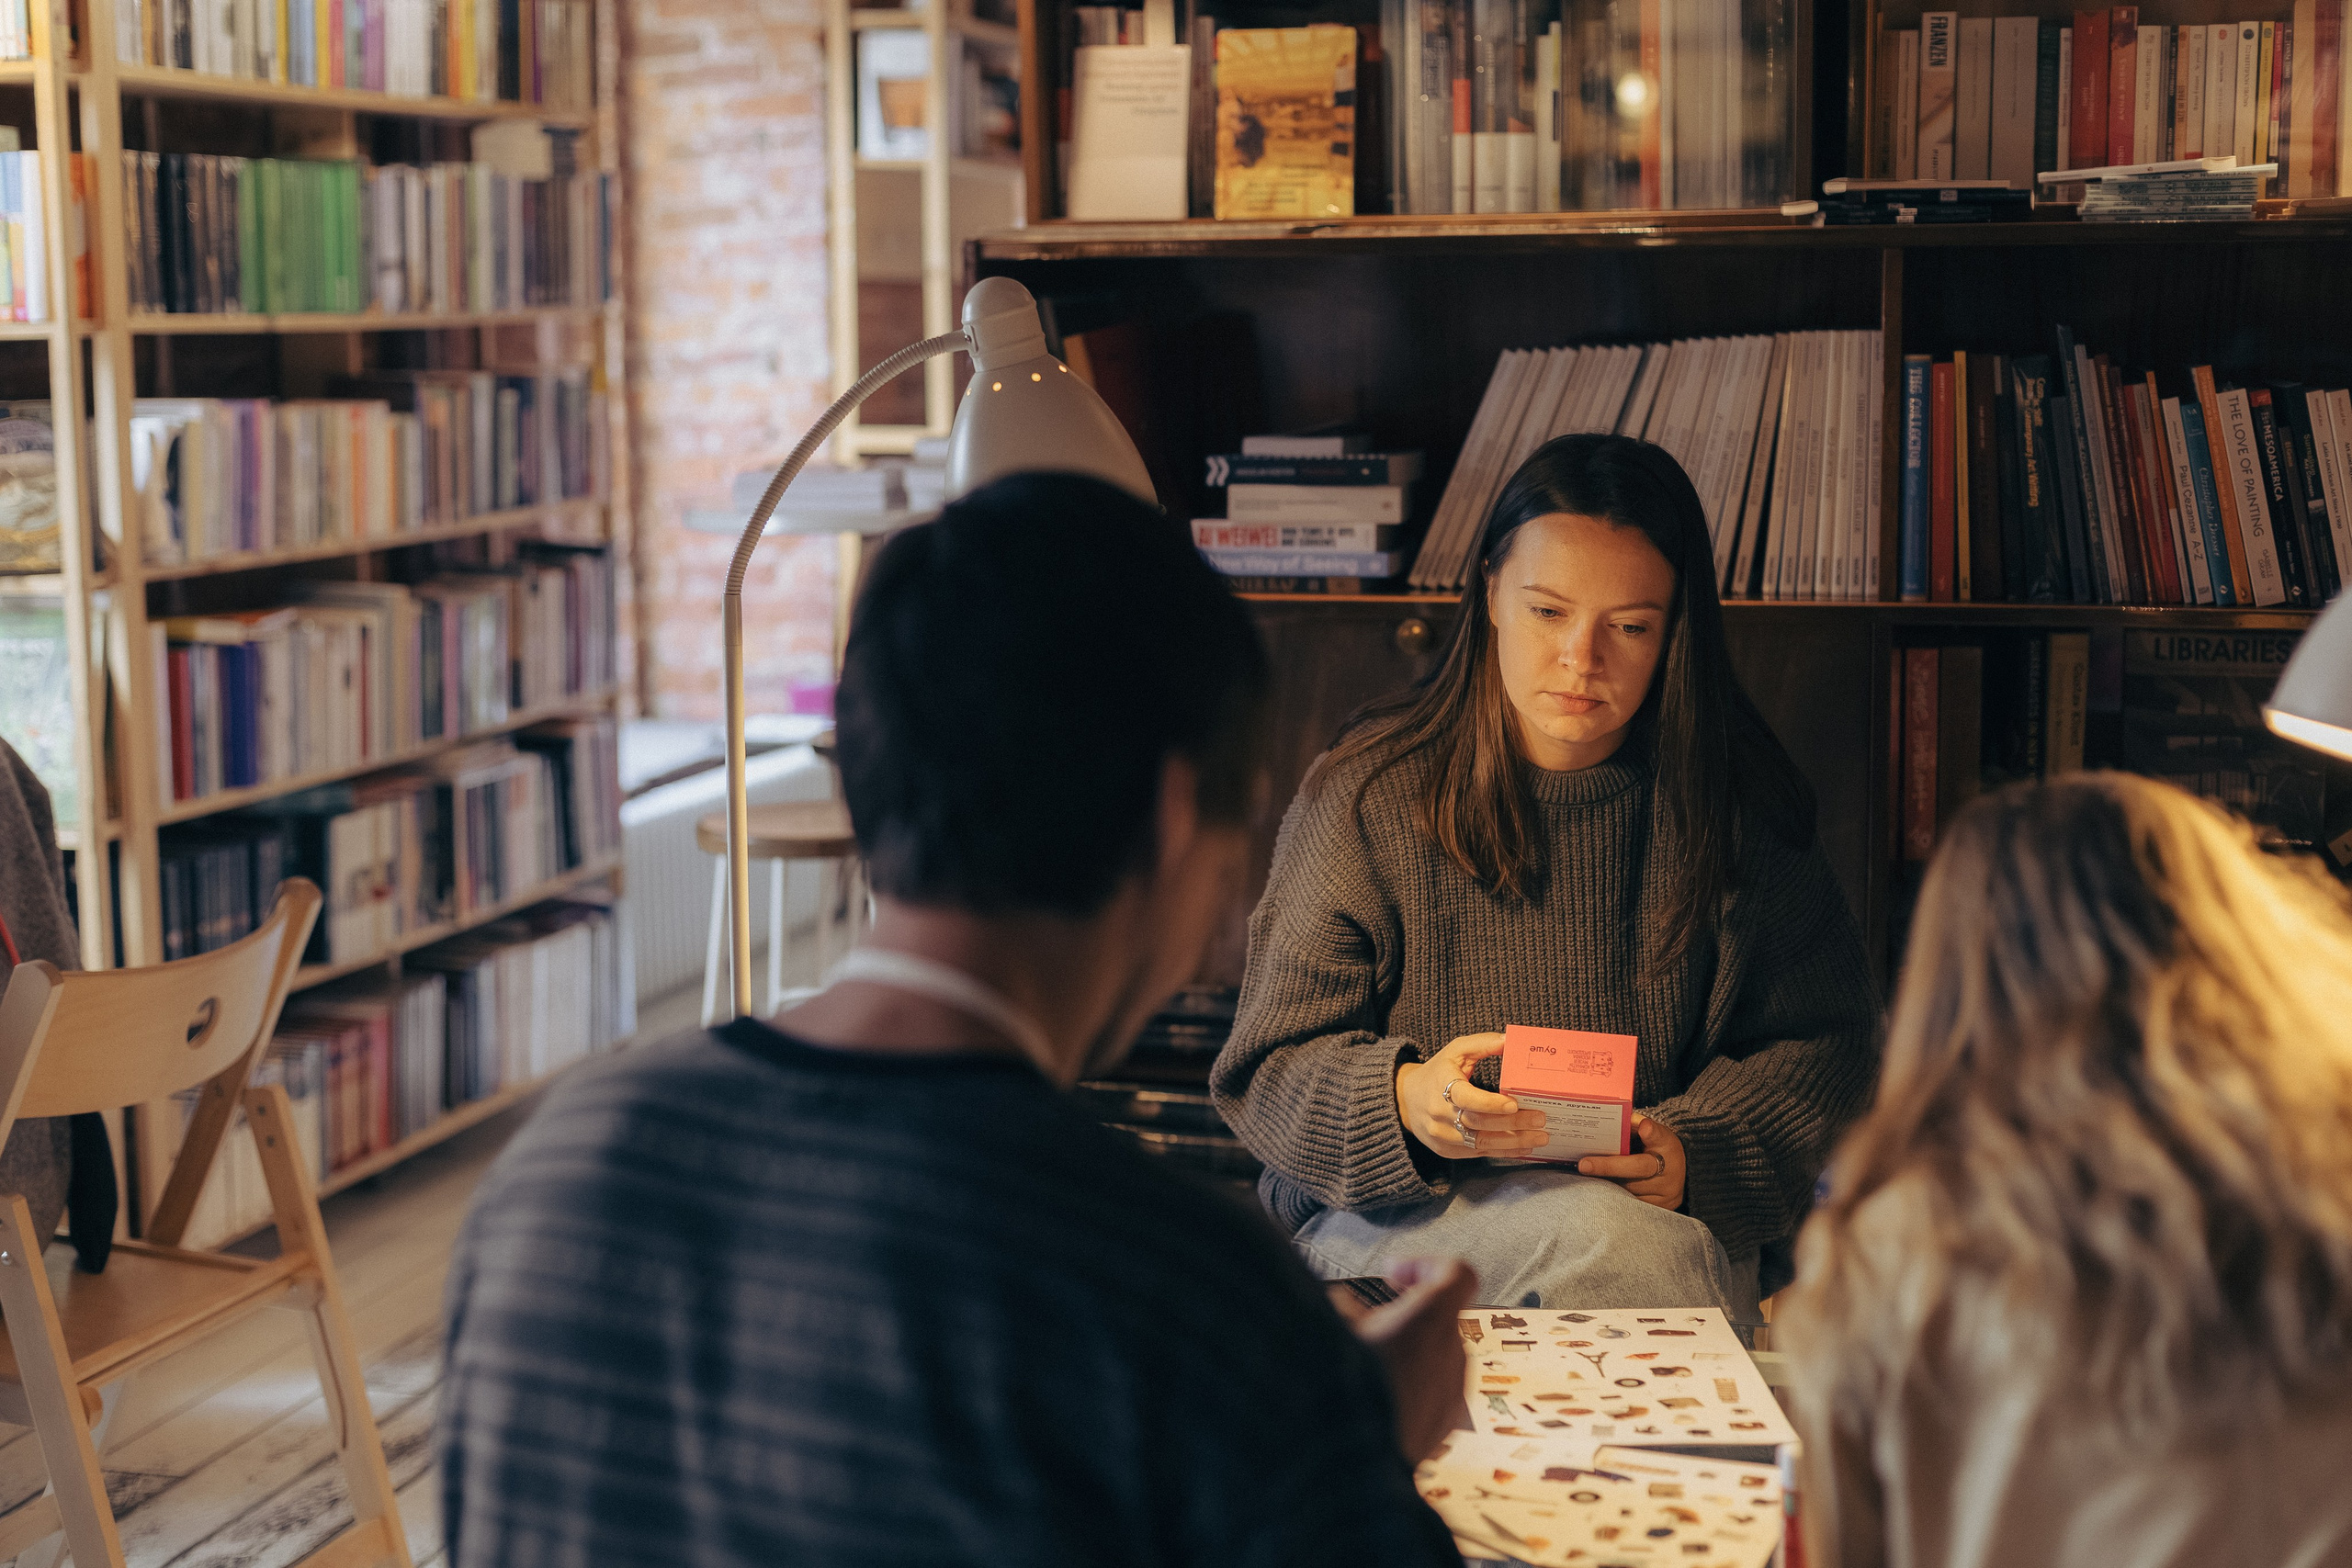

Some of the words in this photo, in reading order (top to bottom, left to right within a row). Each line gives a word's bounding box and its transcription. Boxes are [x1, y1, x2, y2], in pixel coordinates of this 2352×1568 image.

[1929, 16, 1948, 67] FRANZEN
[1908, 367, 1923, 395] THE
[2227, 396, 2242, 422] THE
[2233, 423, 2248, 456] LOVE
[2239, 459, 2252, 476] OF
[2263, 425, 2284, 502] MESOAMERICA
[2304, 434, 2315, 476] Surrealism
[2178, 465, 2190, 488] Paul
[2324, 460, 2334, 485] American
[2182, 489, 2197, 535] Cezanne
[2198, 467, 2215, 521] Christopher
[2208, 523, 2221, 558] Dresser
[2244, 479, 2264, 537] PAINTING
[2154, 637, 2291, 663] LIBRARIES
[1530, 1045, 1556, 1055] буше
